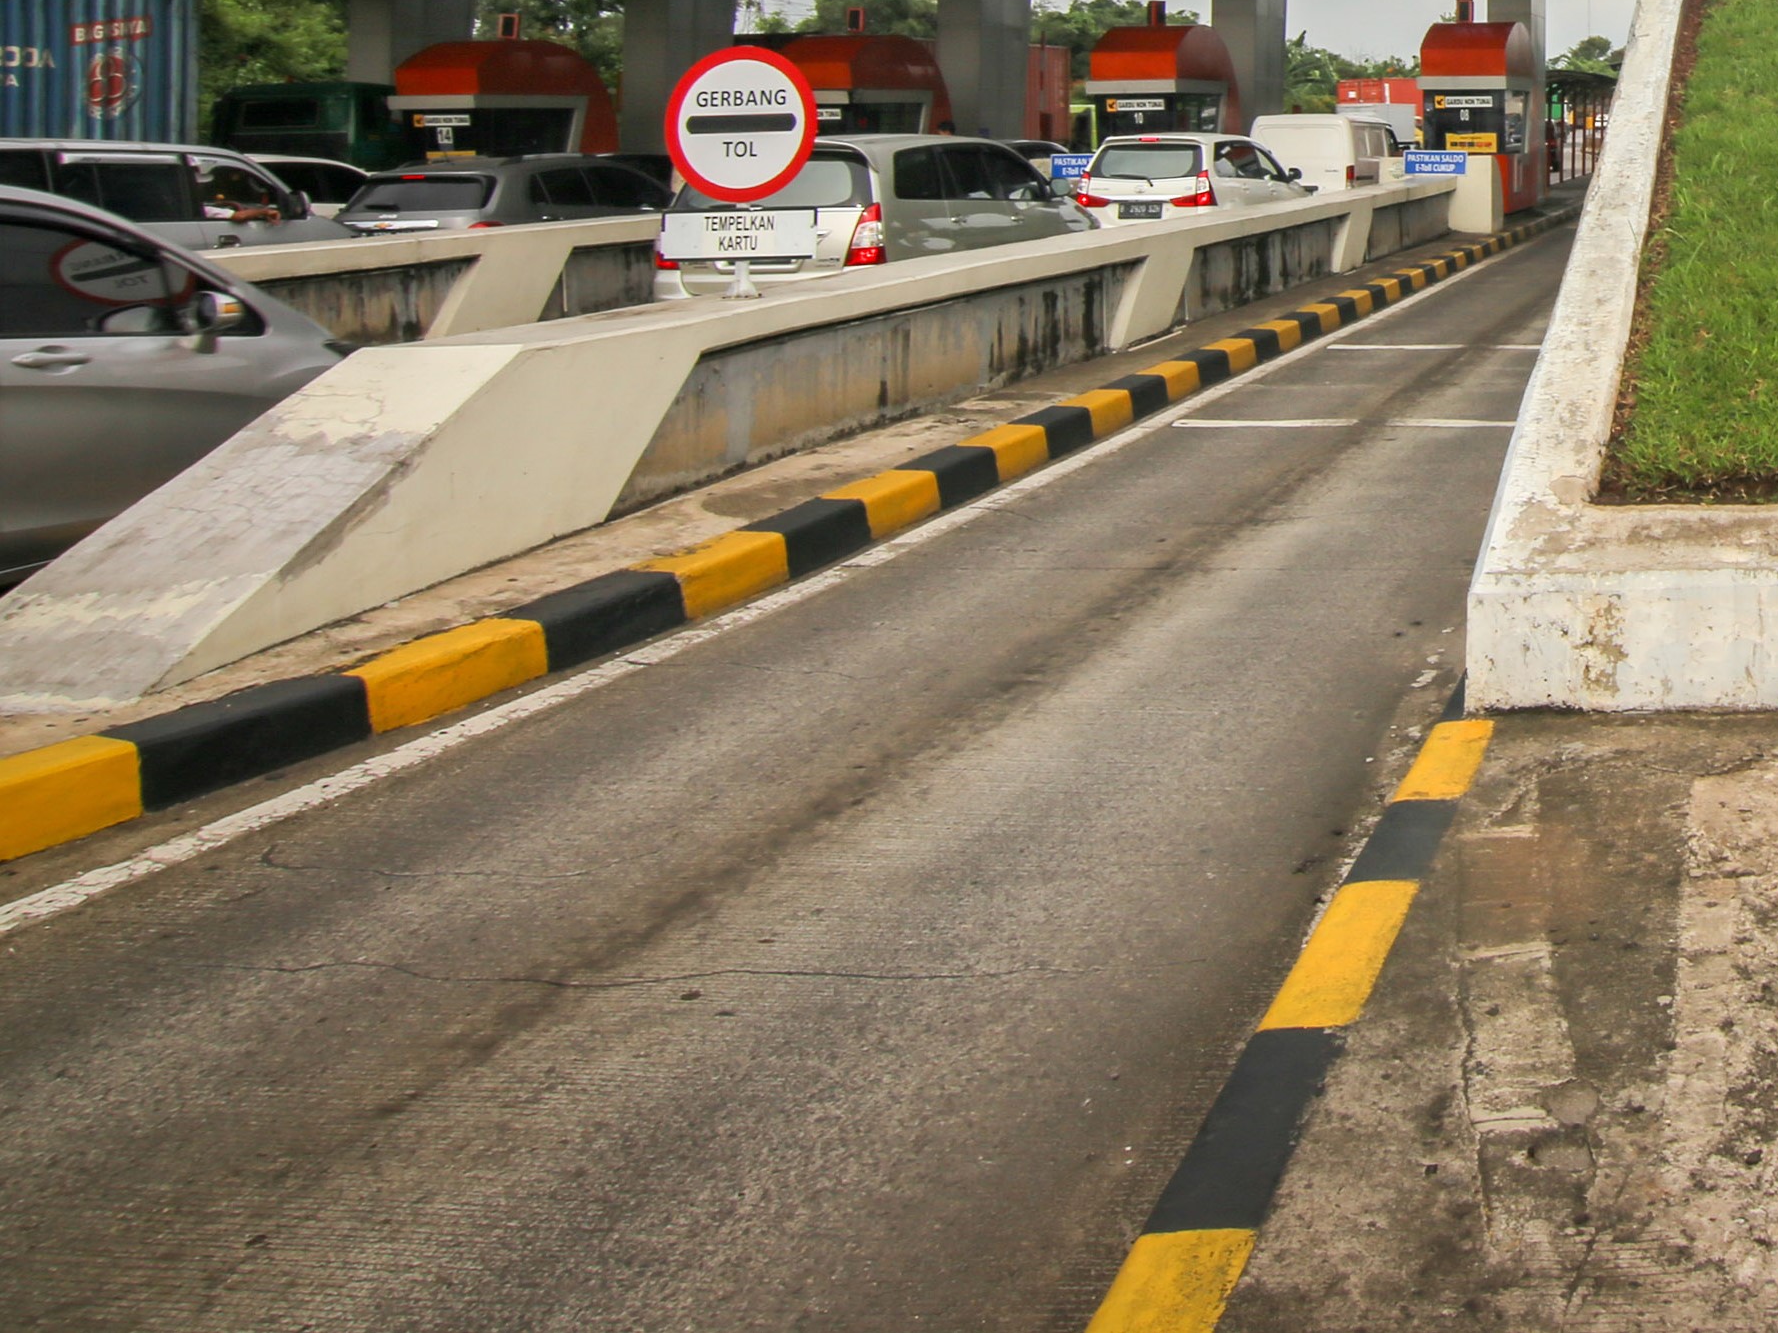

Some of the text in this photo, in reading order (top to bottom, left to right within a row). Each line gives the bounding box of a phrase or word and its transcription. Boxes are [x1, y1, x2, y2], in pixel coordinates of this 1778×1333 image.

[696, 89, 786, 107] GERBANG
[438, 129, 451, 142] 14
[722, 141, 757, 157] TOL
[1054, 157, 1087, 165] PASTIKAN
[1407, 154, 1464, 163] PASTIKAN SALDO
[704, 216, 774, 231] TEMPELKAN
[718, 236, 757, 251] KARTU
